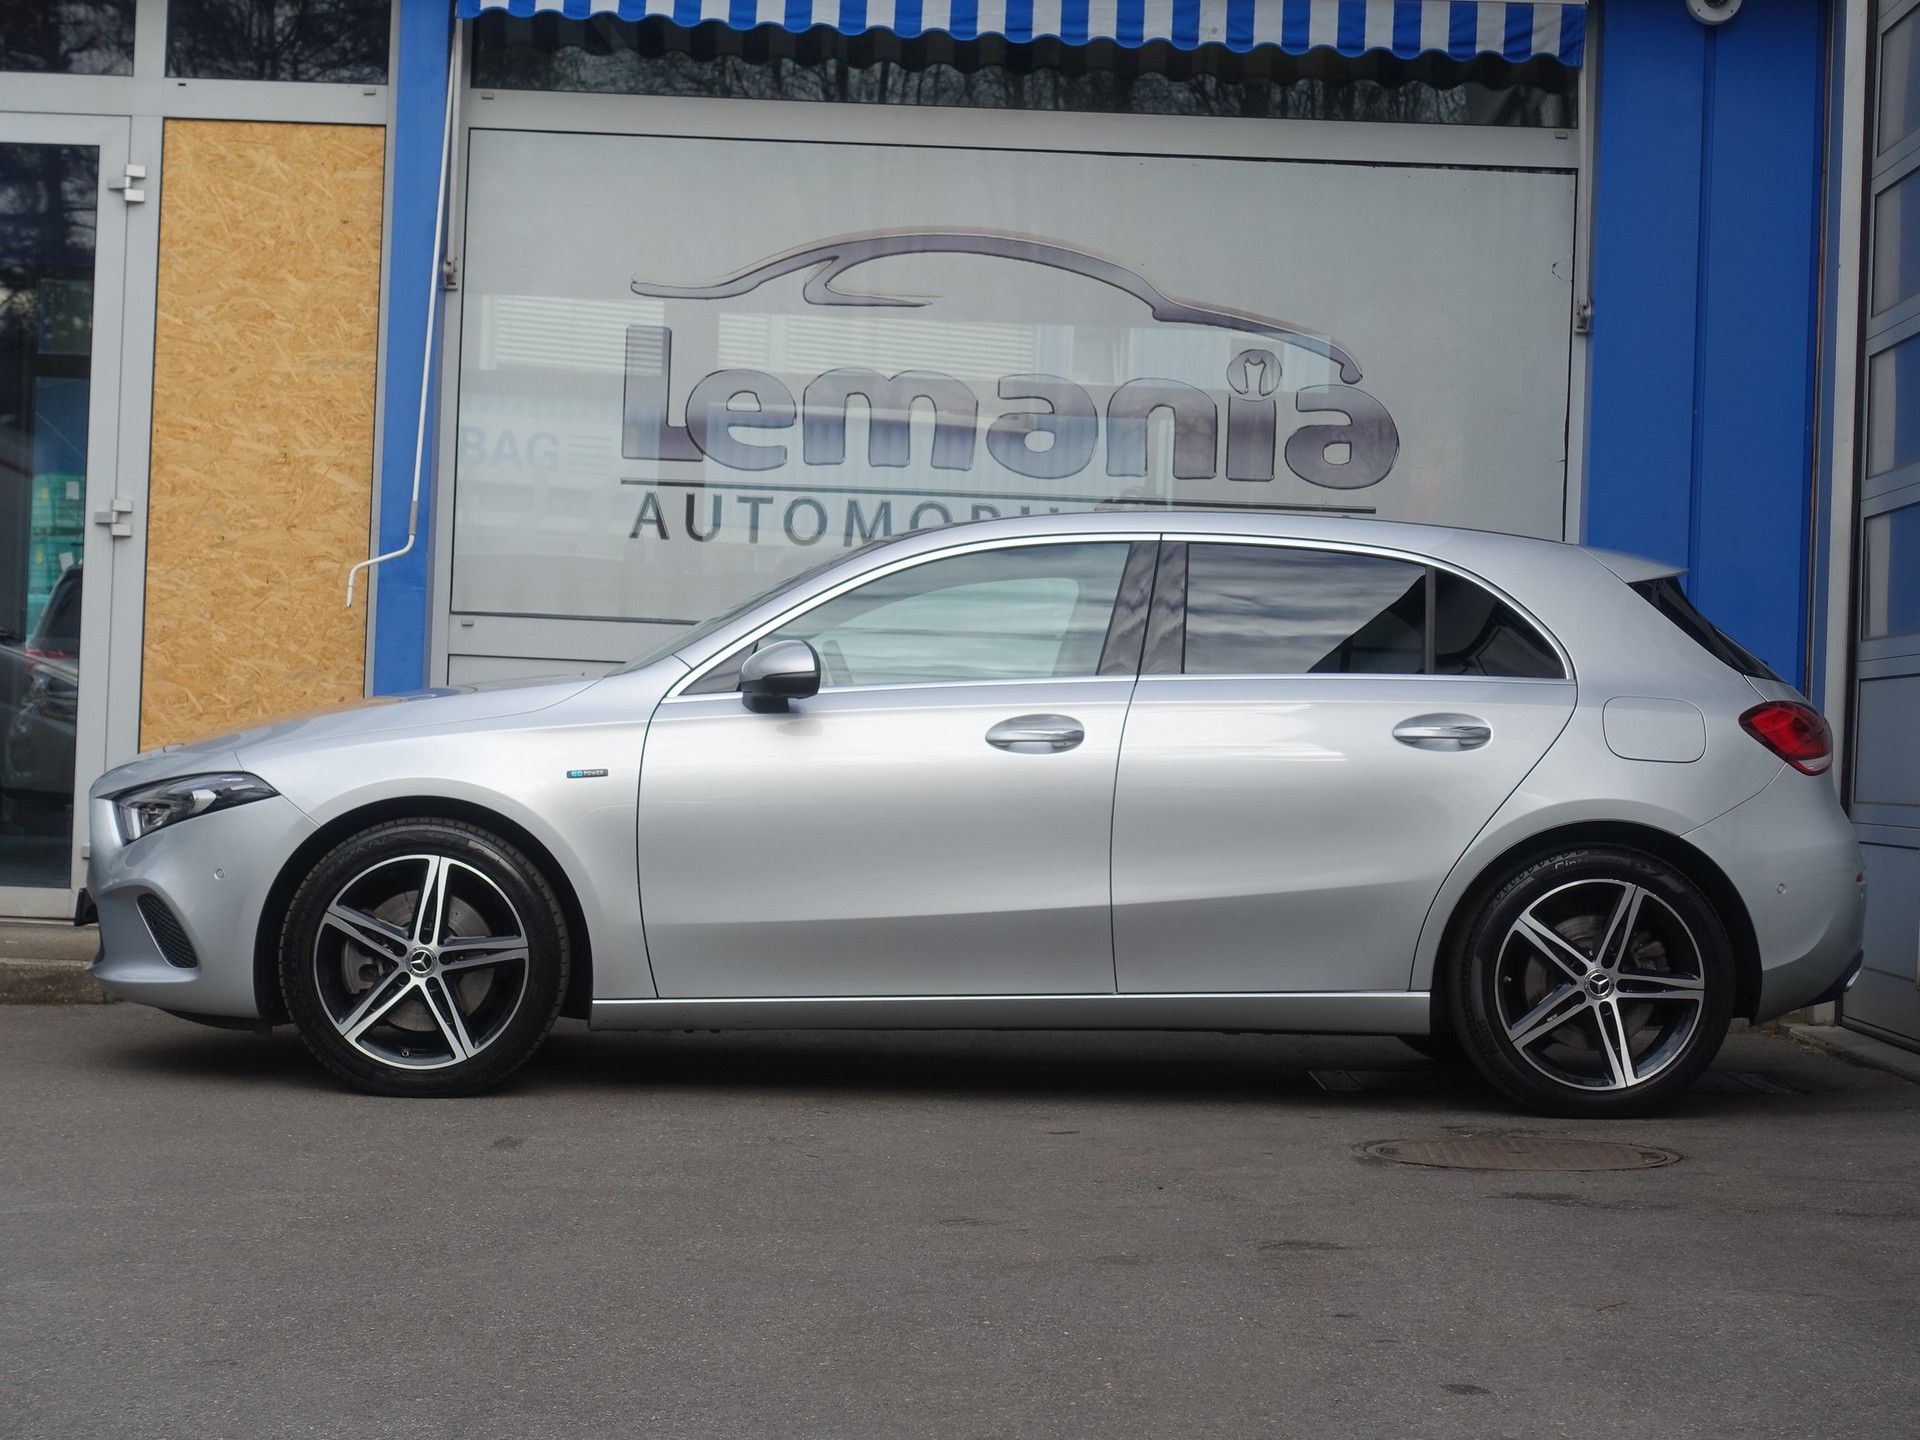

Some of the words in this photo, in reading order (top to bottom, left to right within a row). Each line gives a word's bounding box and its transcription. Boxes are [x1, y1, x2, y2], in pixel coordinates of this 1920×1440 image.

[620, 325, 1400, 490] Lemania
[460, 425, 560, 473] BAG
[628, 490, 1060, 548] AUTOMO
